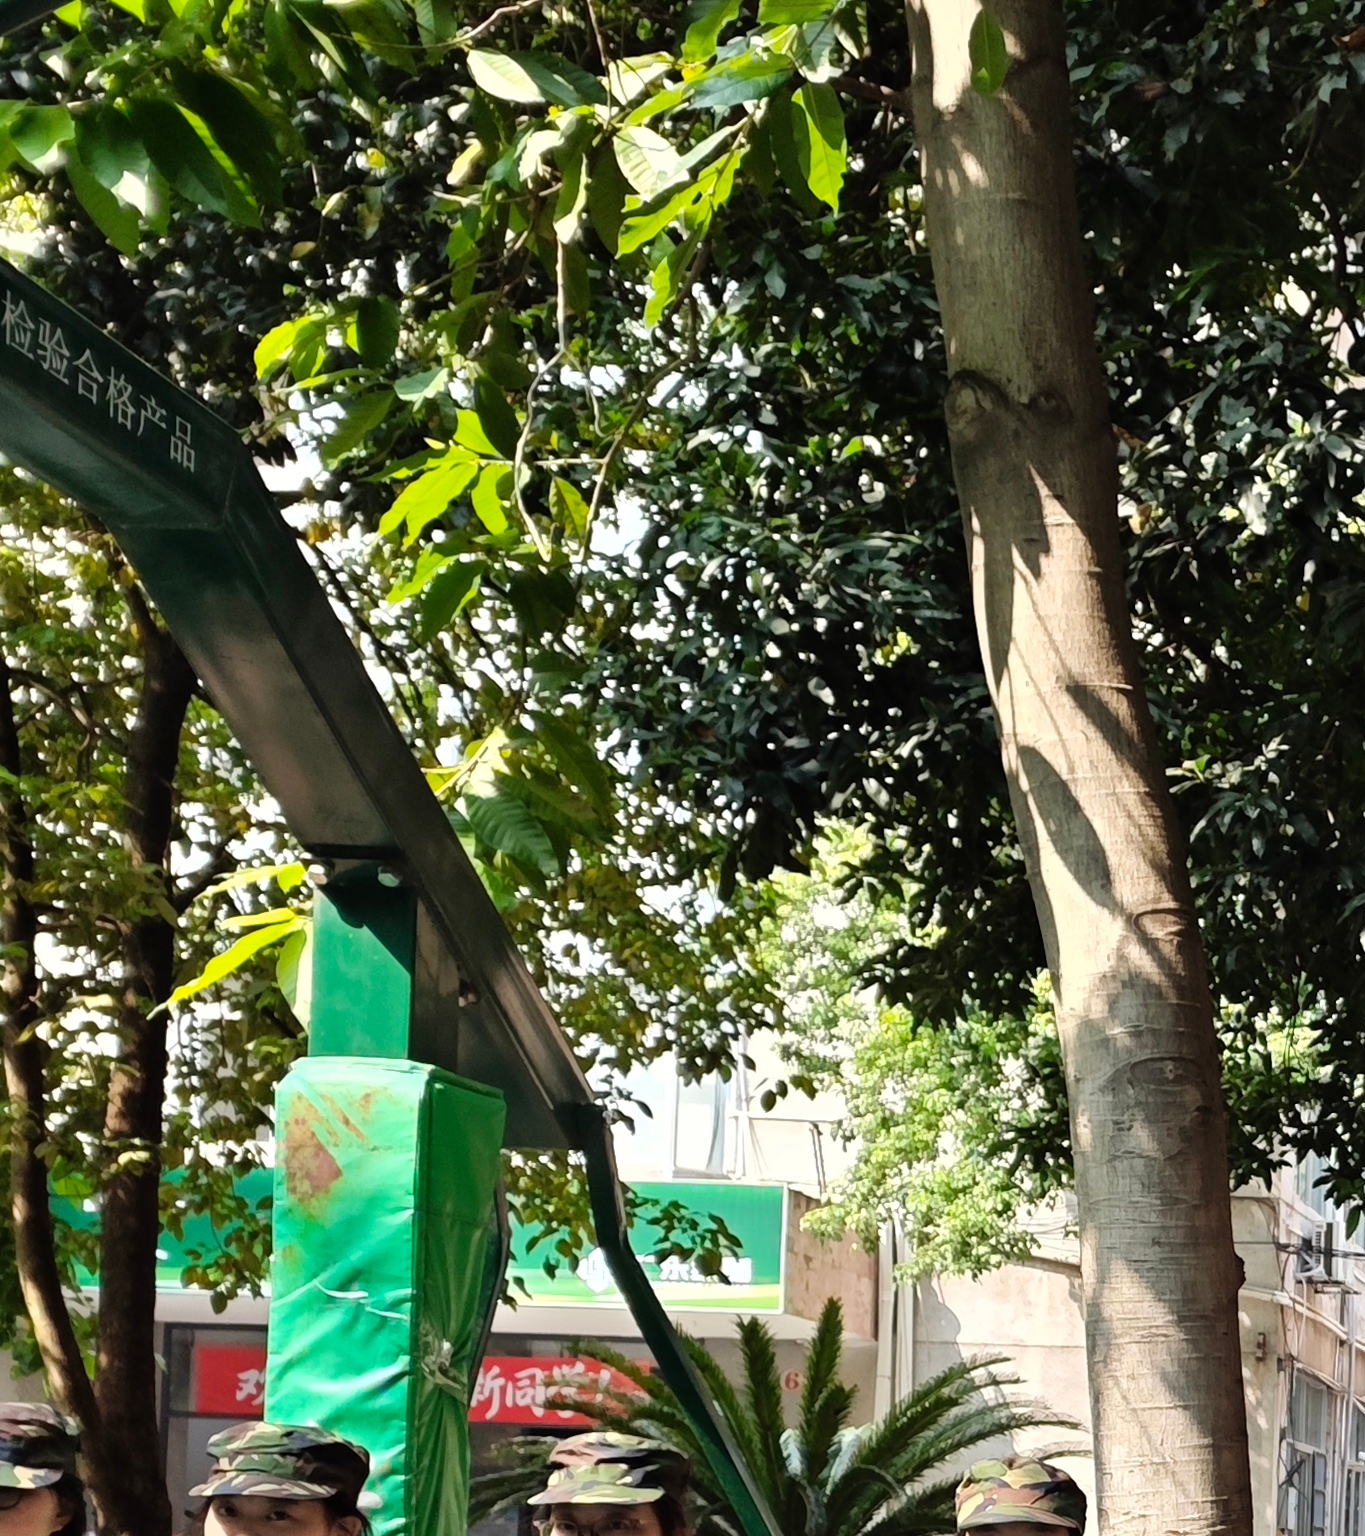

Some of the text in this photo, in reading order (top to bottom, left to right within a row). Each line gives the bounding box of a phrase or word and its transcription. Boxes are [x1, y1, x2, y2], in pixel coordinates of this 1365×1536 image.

[2, 289, 196, 473] 检验合格产品
[784, 1371, 800, 1391] 6
